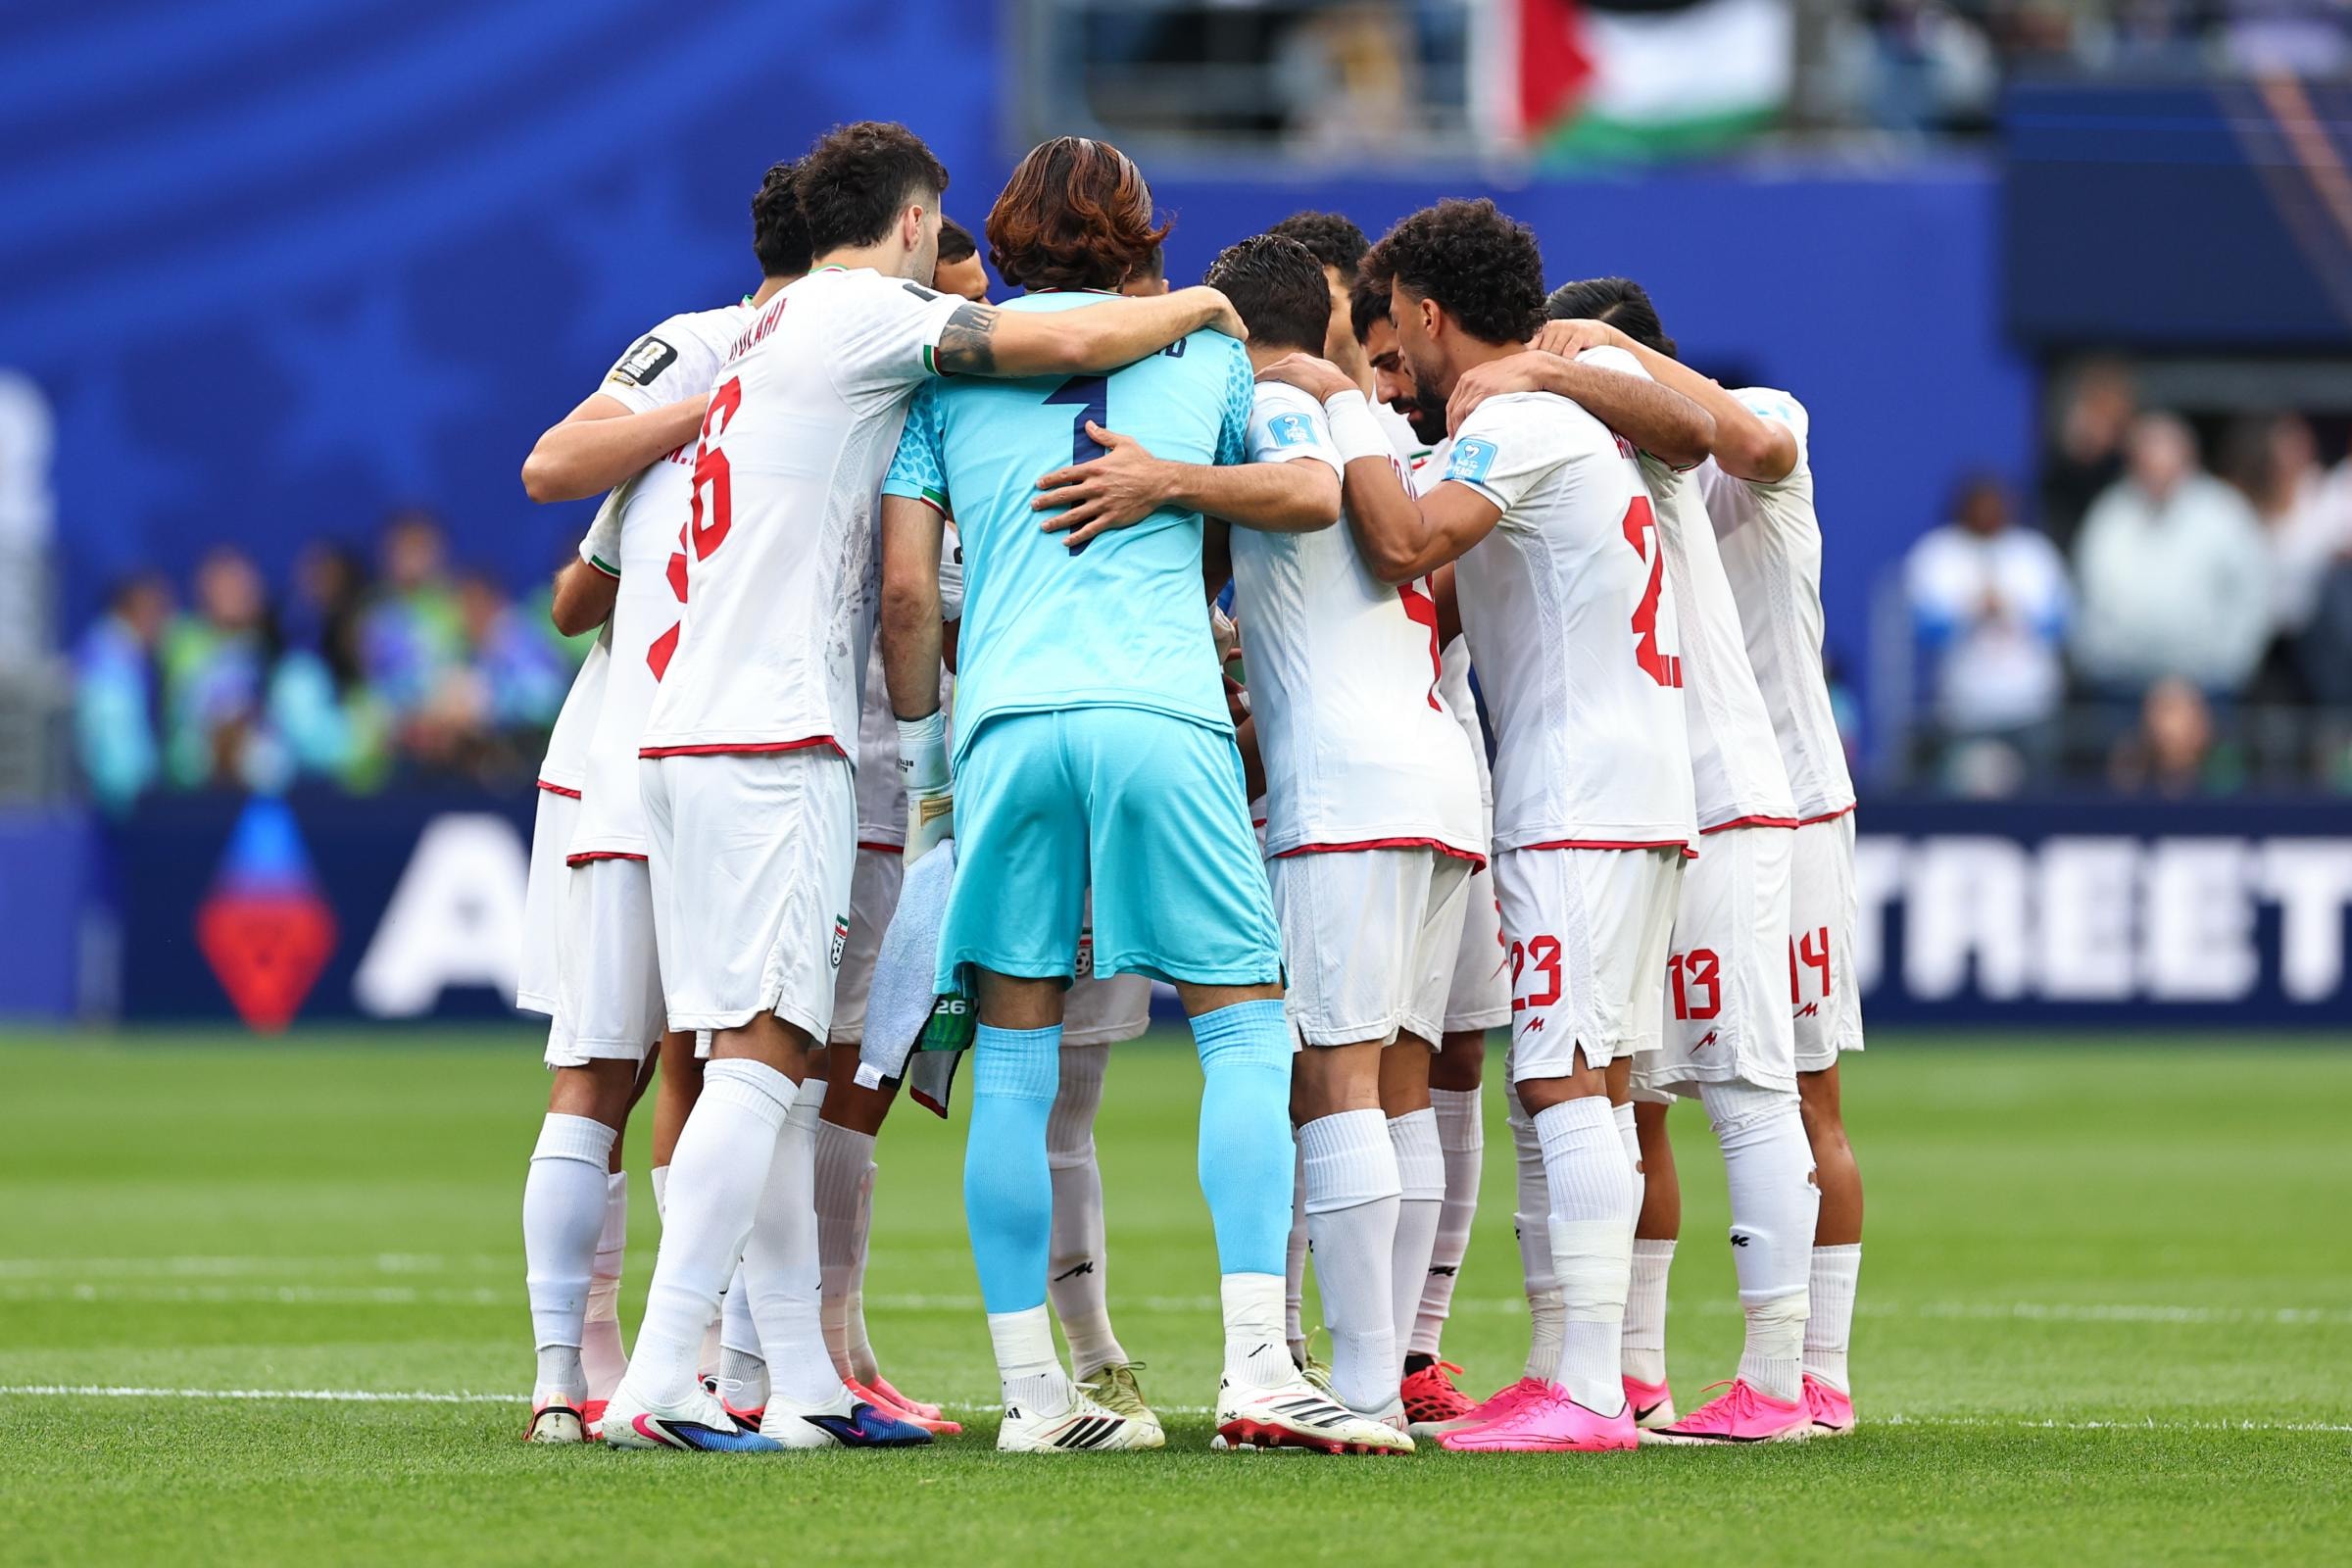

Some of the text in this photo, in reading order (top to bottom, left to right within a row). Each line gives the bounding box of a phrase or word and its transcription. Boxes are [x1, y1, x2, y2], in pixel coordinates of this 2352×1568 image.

[691, 375, 742, 563] 6
[1041, 375, 1108, 557] 1
[1622, 495, 1685, 689] 2
[1510, 934, 1562, 1012] 23
[1667, 948, 1721, 1020] 13
[1788, 926, 1831, 1004] 14
[934, 1000, 966, 1015] 26
